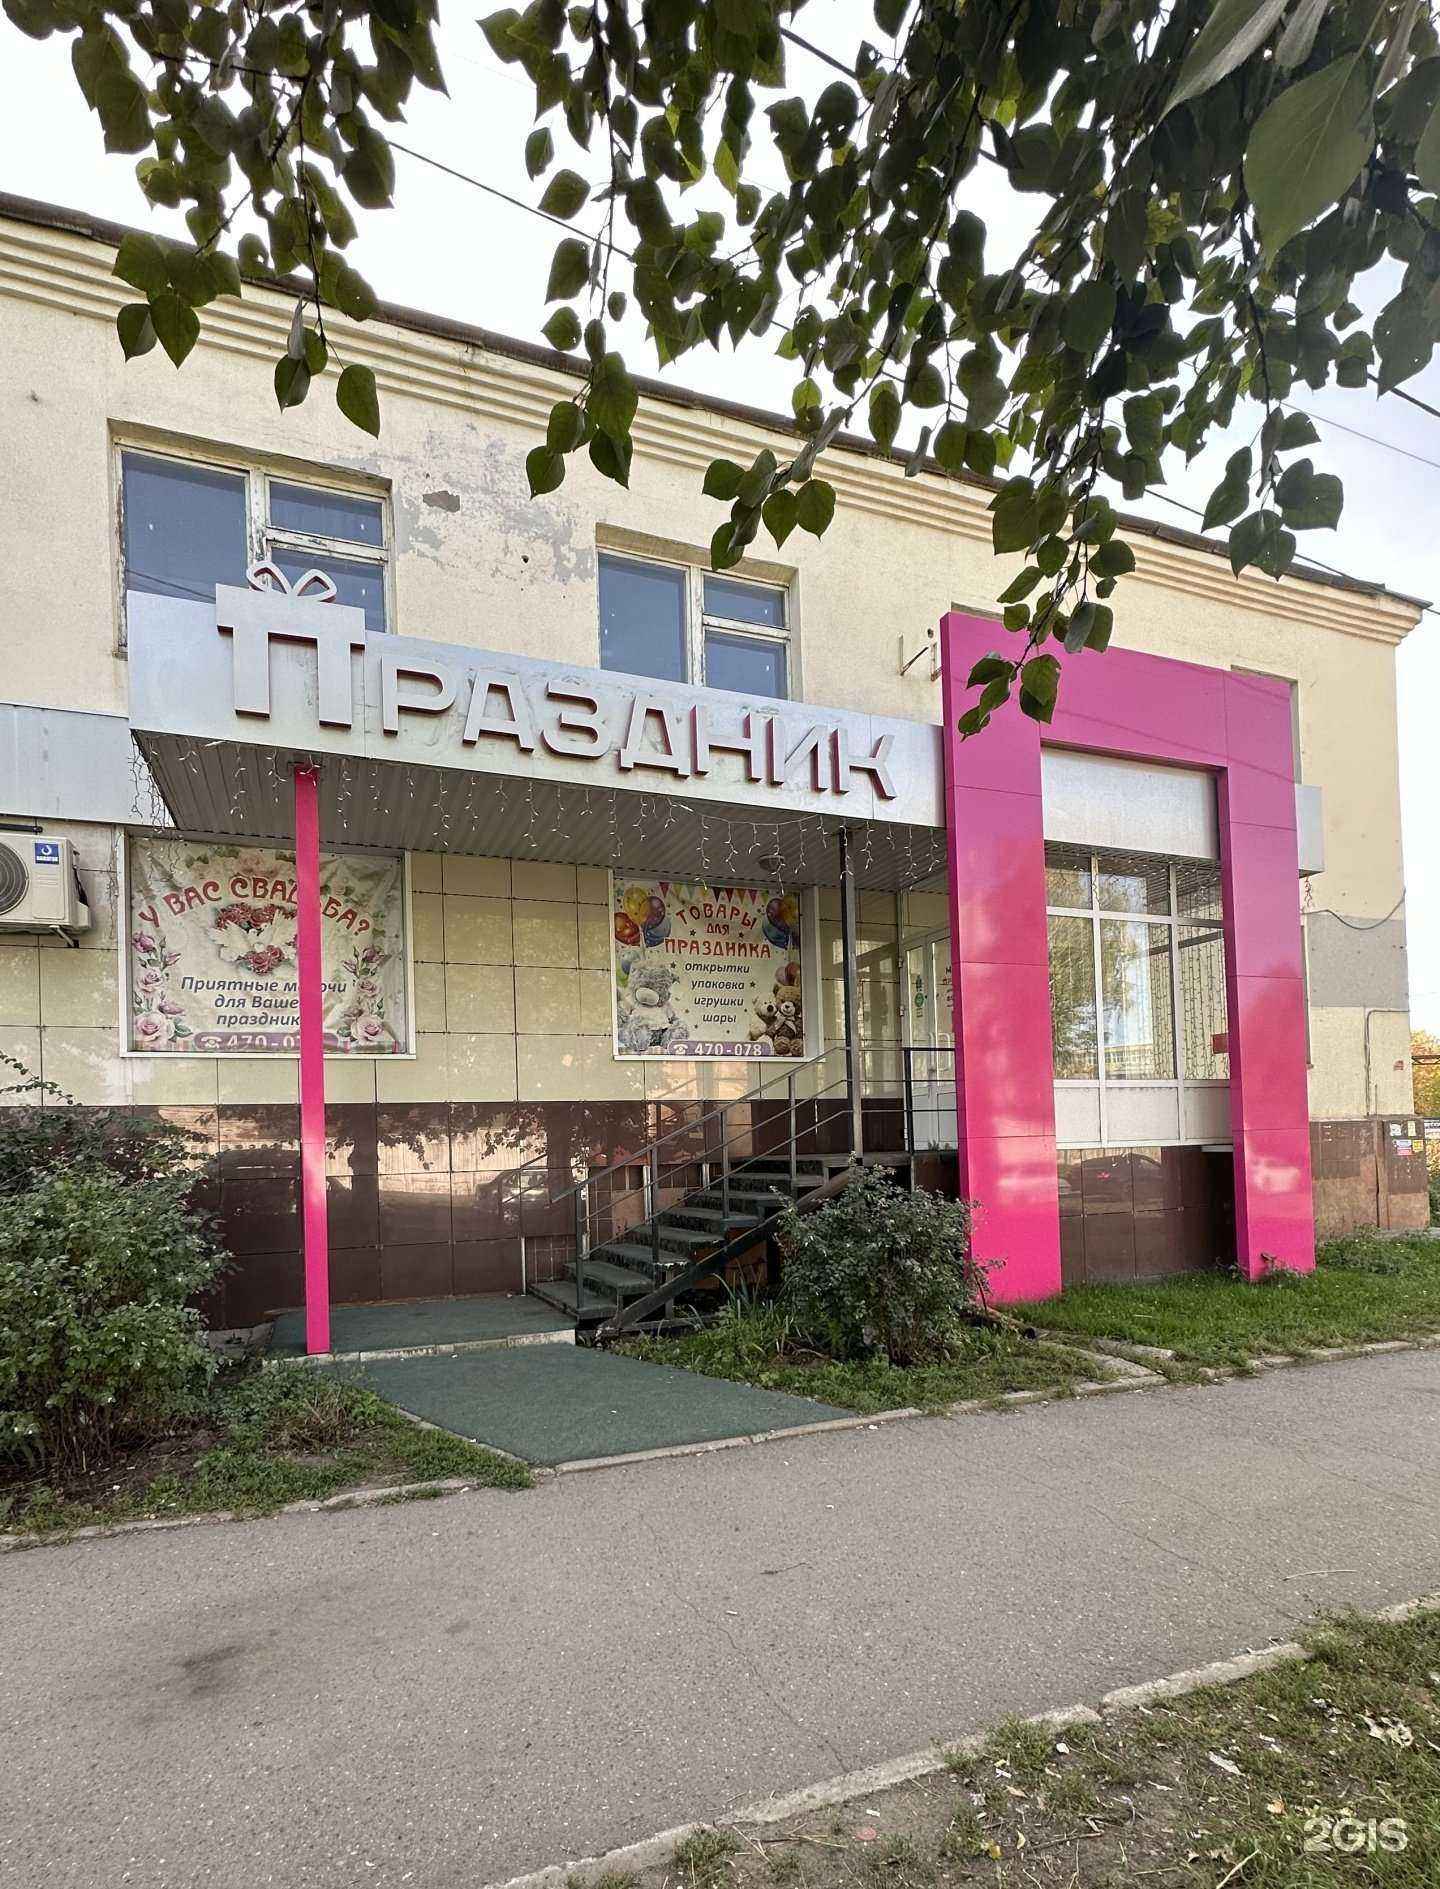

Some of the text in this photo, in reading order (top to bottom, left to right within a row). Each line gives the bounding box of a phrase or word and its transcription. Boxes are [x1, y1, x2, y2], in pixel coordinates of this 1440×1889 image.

[138, 877, 370, 936] У ВАС СВАДБА?
[675, 903, 757, 930] ТОВАРЫ
[664, 938, 772, 959] ПРАЗДНИКА
[685, 960, 750, 975] открытки
[181, 976, 347, 993] Приятные мочи
[691, 978, 745, 991] упаковка
[214, 993, 301, 1009] для Ваше
[694, 997, 744, 1008] игрушки
[216, 1010, 302, 1026] праздник
[702, 1014, 737, 1025] шары
[694, 1042, 762, 1056] 470-078
